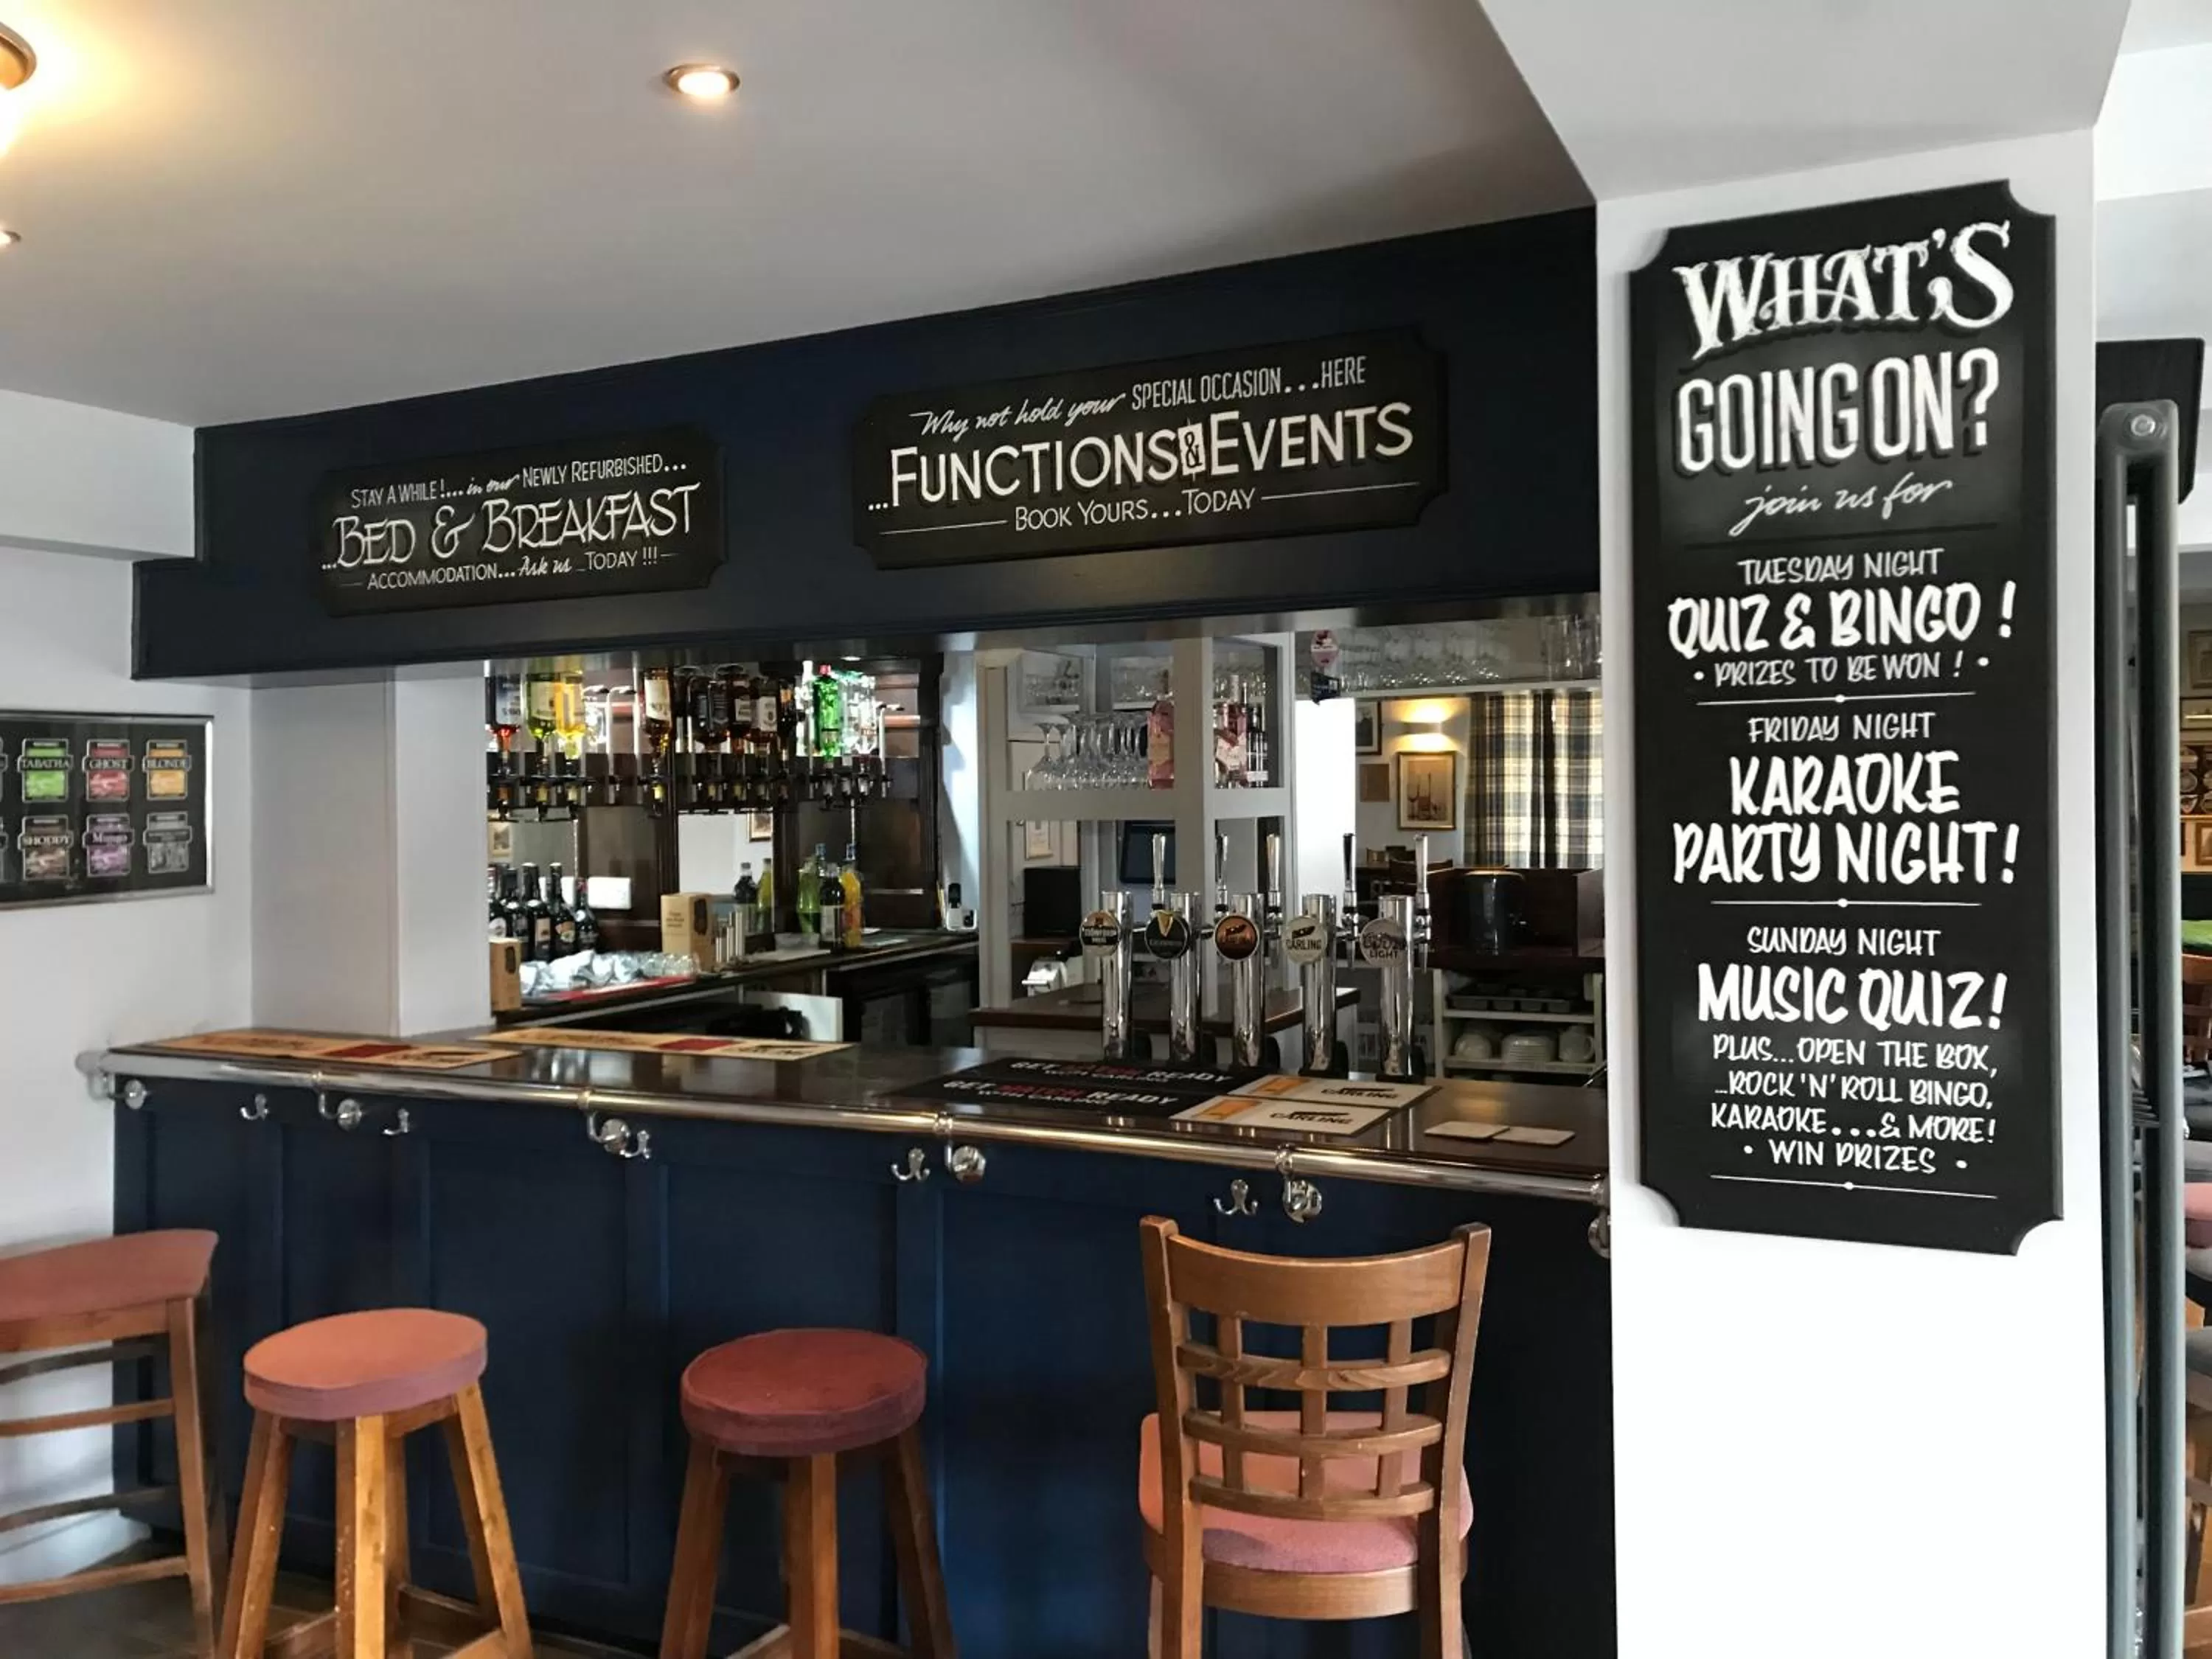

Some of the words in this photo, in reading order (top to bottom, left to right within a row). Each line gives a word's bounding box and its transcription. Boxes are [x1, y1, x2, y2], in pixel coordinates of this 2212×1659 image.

[1672, 220, 2014, 361] WHAT'S
[908, 409, 969, 442] Why
[975, 406, 1012, 428] not
[1014, 397, 1064, 425] hold
[1064, 392, 1127, 427] your
[1131, 377, 1197, 411] SPECIAL
[1677, 362, 1860, 473] GOING
[1871, 347, 2000, 458] ON?
[1180, 426, 1205, 473] &
[1210, 401, 1414, 478] EVENTS
[350, 487, 384, 509] STAY
[386, 484, 397, 505] A
[522, 465, 567, 489] NEWLY
[1728, 482, 1823, 538] join
[1834, 484, 1879, 510] us
[1881, 471, 1954, 521] for
[431, 505, 476, 559] &
[480, 481, 701, 553] BREAKFAST
[1015, 505, 1072, 532] BOOK
[516, 555, 548, 577] Ask
[552, 557, 572, 574] us
[584, 550, 639, 571] TODAY
[1736, 553, 1854, 585] TUESDAY
[1863, 548, 1945, 578] NIGHT
[1667, 594, 1770, 659] QUIZ
[1779, 592, 1816, 650] &
[1829, 581, 1982, 647] BINGO
[1714, 660, 1797, 687] PRIZES
[1804, 657, 1837, 684] TO
[1847, 655, 1877, 683] BE
[1881, 652, 1941, 681] WON
[1747, 715, 1840, 744] FRIDAY
[1852, 712, 1936, 740] NIGHT
[89, 759, 128, 769] GHOST
[1729, 750, 1961, 817] KARAOKE
[1672, 821, 1822, 885] PARTY
[1285, 939, 1322, 950] CARLING
[1369, 950, 1399, 959] LIGHT
[1746, 927, 1848, 956] SUNDAY
[1857, 928, 1941, 957] NIGHT
[1697, 962, 1849, 1024] MUSIC
[1858, 967, 2008, 1032] QUIZ!
[1144, 1069, 1234, 1083] READY
[1796, 1036, 1866, 1066] OPEN
[1876, 1040, 1929, 1070] THE
[1935, 1043, 1998, 1079] BOX,
[1085, 1090, 1180, 1105] READY
[1840, 1076, 1903, 1105] ROLL
[1908, 1079, 1994, 1110] BINGO,
[1907, 1113, 1997, 1144] MORE!
[1768, 1138, 1825, 1167] WIN
[1835, 1141, 1937, 1175] PRIZES
